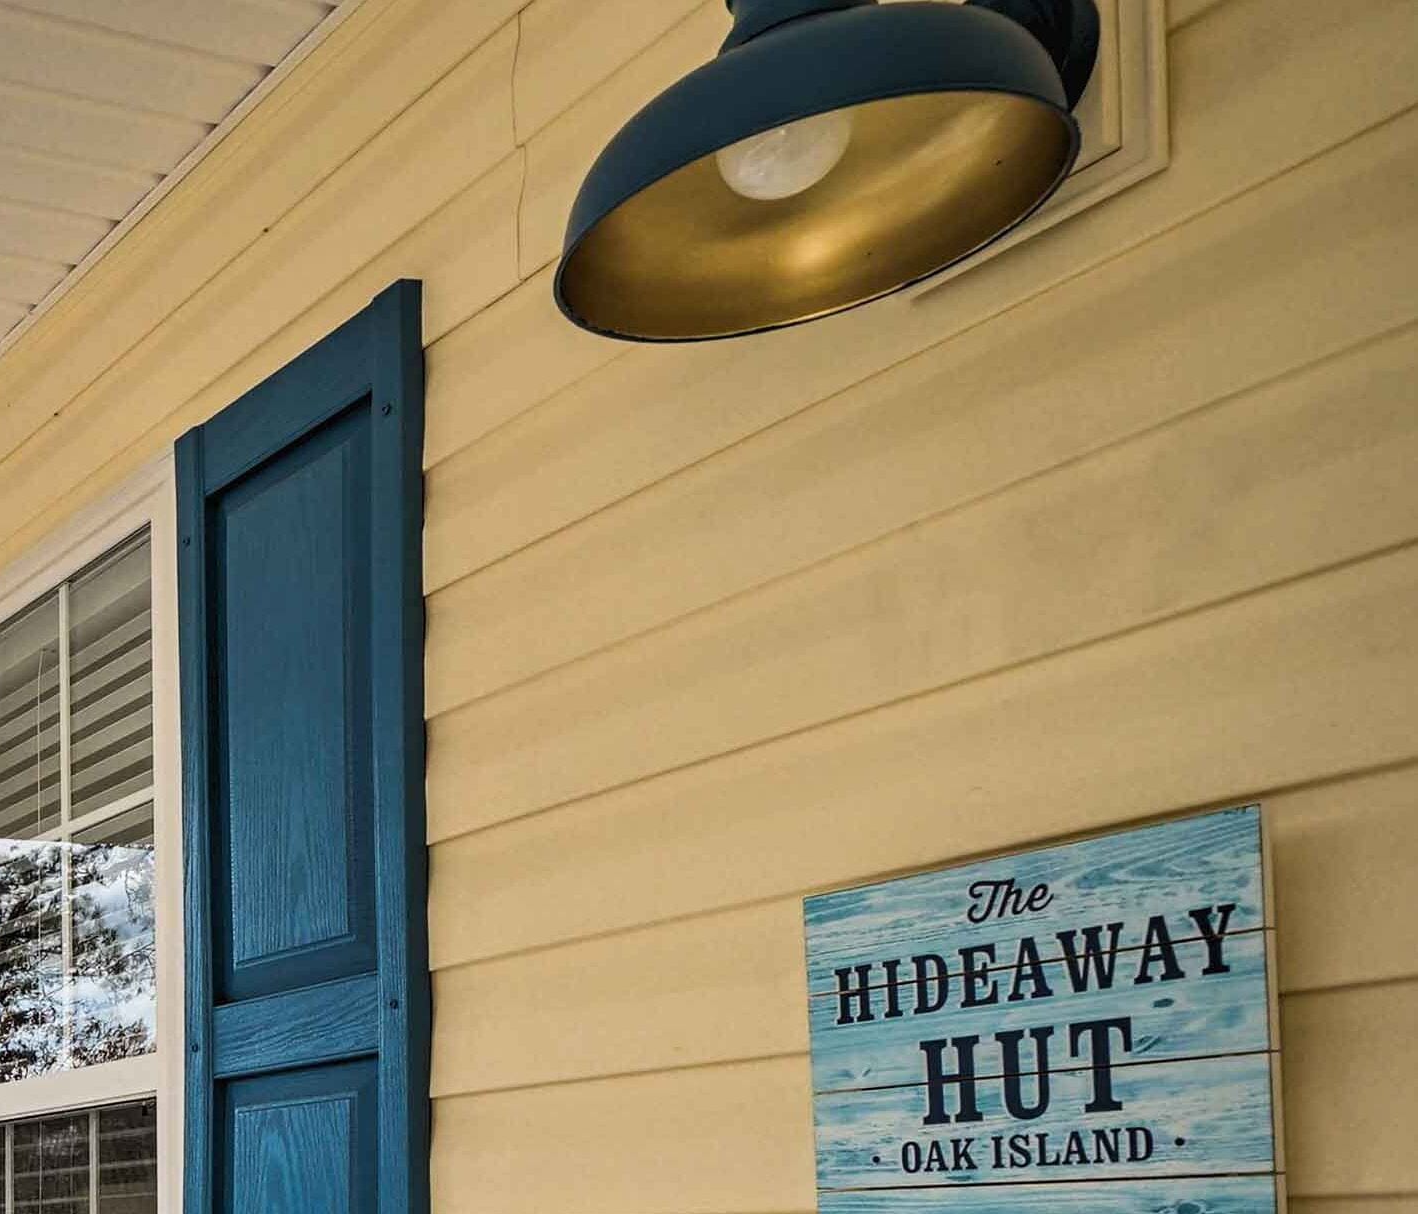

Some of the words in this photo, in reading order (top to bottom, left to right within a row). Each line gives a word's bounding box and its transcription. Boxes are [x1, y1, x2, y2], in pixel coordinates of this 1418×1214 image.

[966, 877, 1054, 924] The
[834, 903, 1237, 1025] HIDEAWAY
[919, 1016, 1134, 1126] HUT
[901, 1140, 978, 1174] OAK
[991, 1126, 1154, 1169] ISLAND
